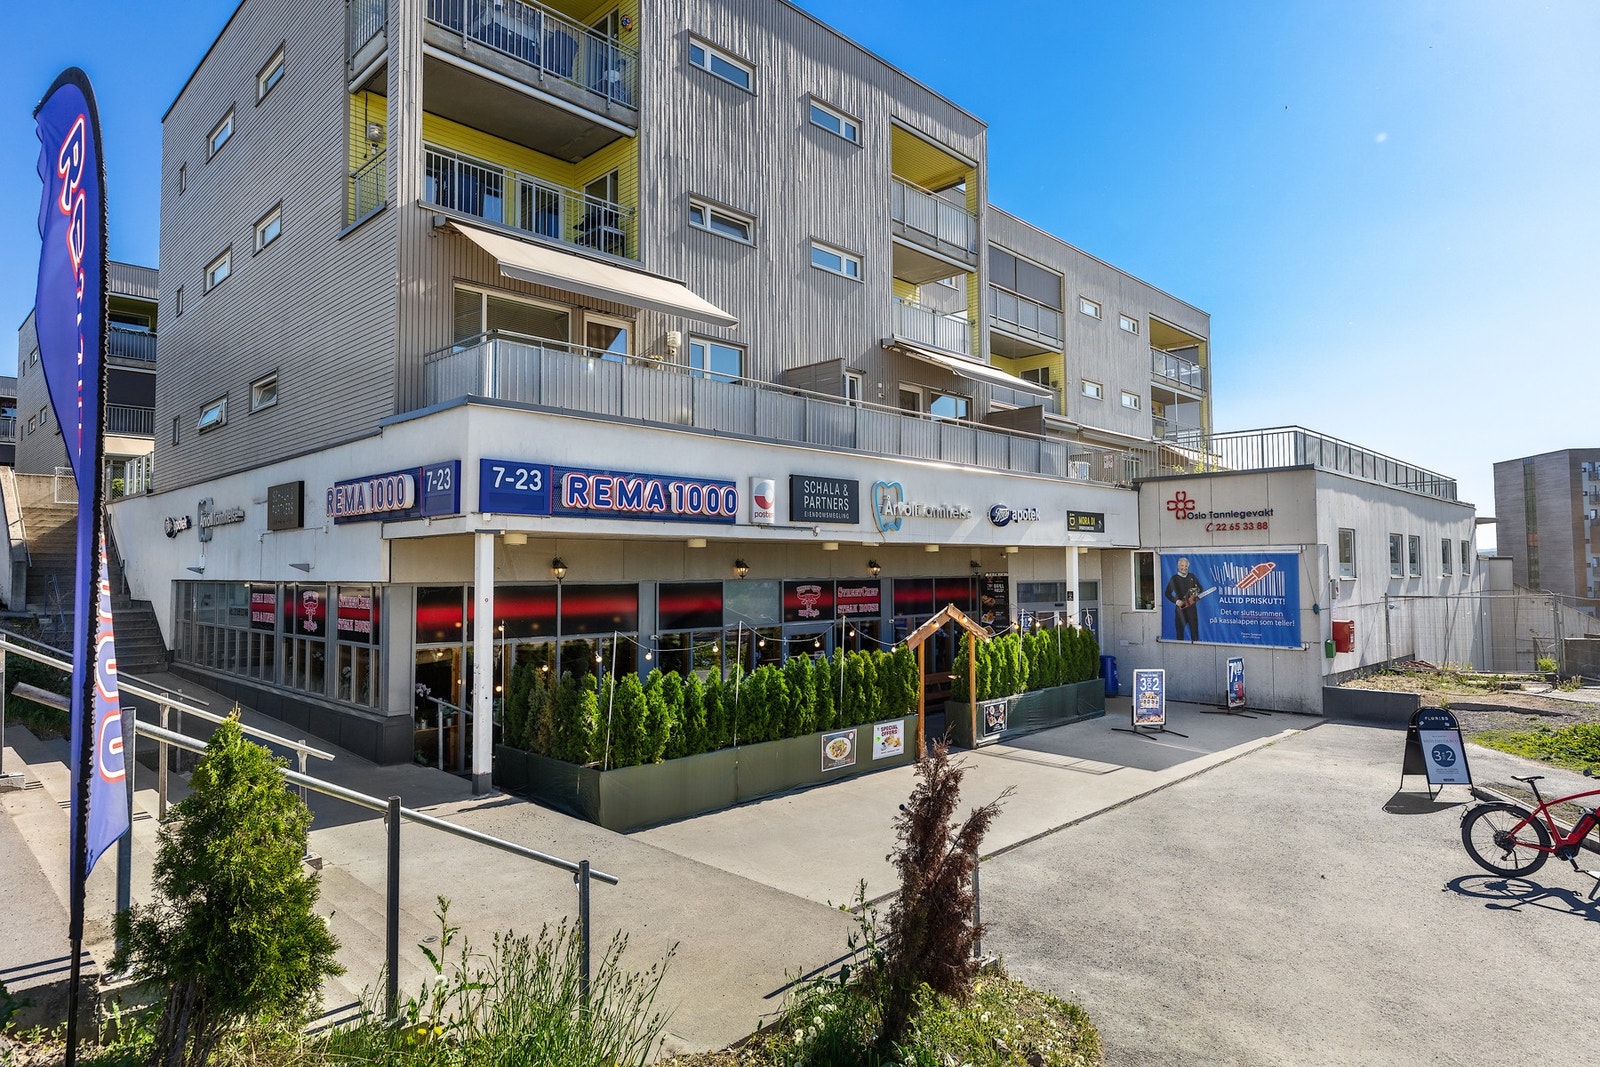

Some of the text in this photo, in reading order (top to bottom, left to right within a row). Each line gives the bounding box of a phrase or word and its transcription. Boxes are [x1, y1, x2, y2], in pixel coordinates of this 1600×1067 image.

[426, 467, 452, 492] 7-23
[492, 466, 542, 492] 7-23
[326, 482, 366, 517] REMA
[369, 474, 408, 511] 1000
[562, 472, 739, 517] REMA 1000
[804, 480, 849, 496] SCHALA &
[804, 495, 849, 511] PARTNERS
[1012, 507, 1041, 523] apotek
[1186, 508, 1274, 521] Oslo Tannlegevakt
[1216, 522, 1268, 531] 22 65 33 88
[1245, 597, 1285, 605] PRISKUTT!
[1220, 608, 1232, 616] Det
[1241, 609, 1284, 617] sluttsummen
[1219, 617, 1259, 626] kassalappen
[1275, 619, 1295, 627] teller!
[1139, 677, 1147, 691] 3
[1152, 677, 1160, 691] 2
[1433, 750, 1442, 761] 3
[1446, 750, 1455, 761] 2
